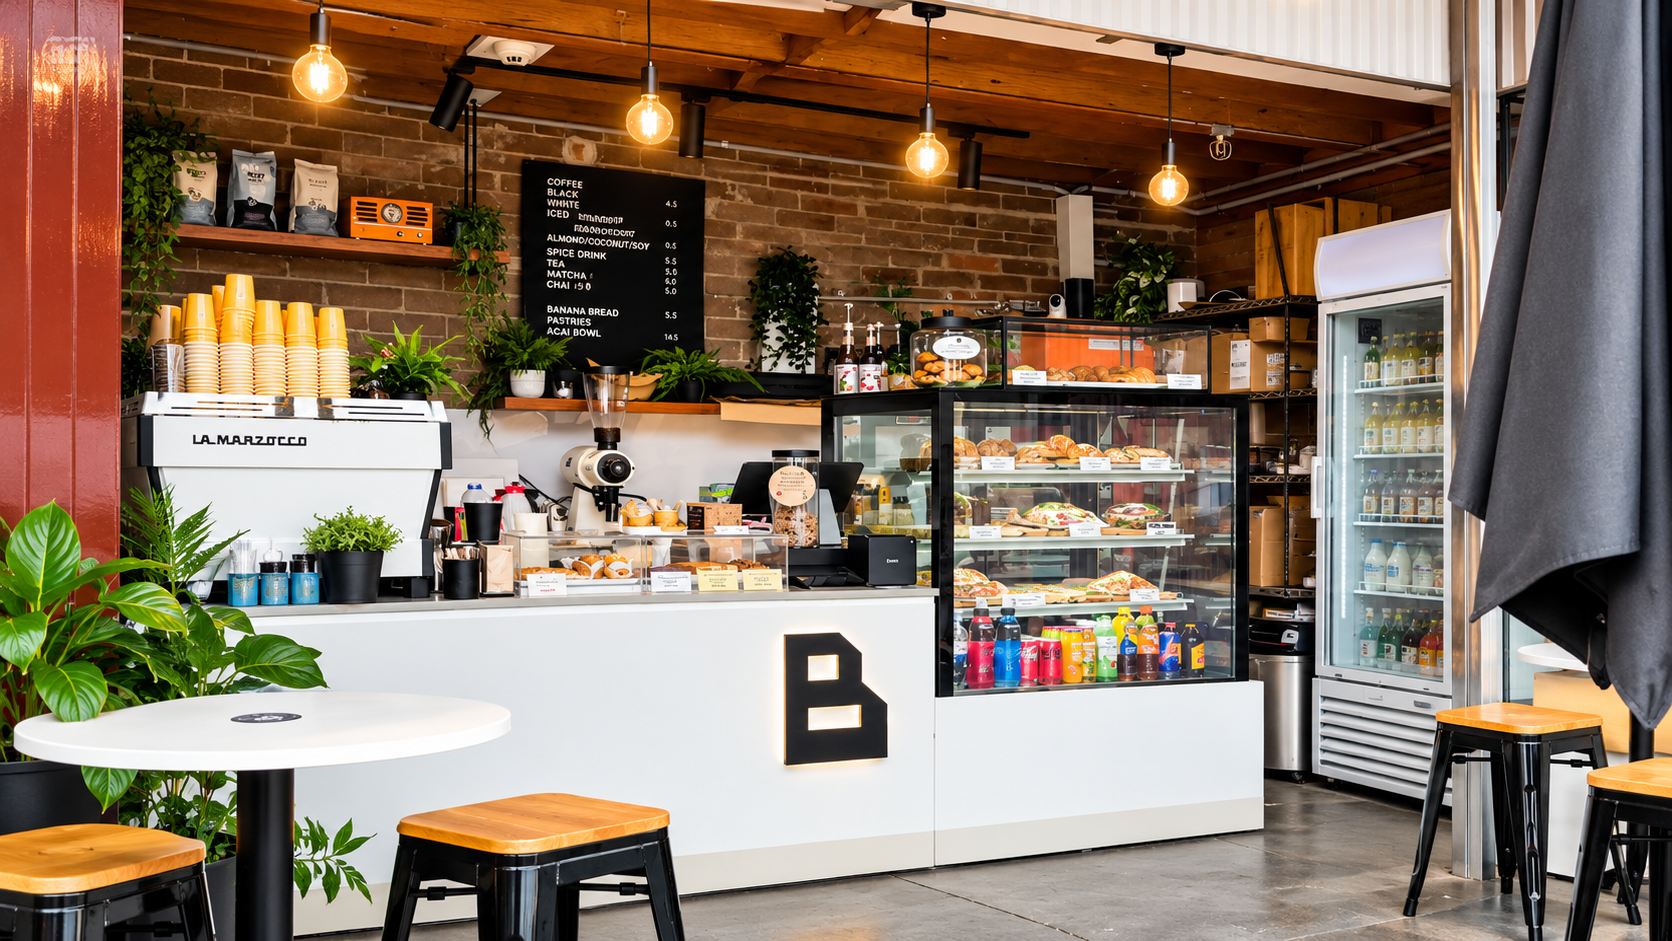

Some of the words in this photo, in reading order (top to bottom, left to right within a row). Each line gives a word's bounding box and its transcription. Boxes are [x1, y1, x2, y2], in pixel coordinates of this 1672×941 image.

[547, 178, 583, 189] COFFEE
[547, 188, 579, 199] BLACK
[665, 200, 678, 208] 4.5
[547, 208, 570, 219] ICED
[665, 219, 678, 228] 0.5
[547, 233, 650, 251] ALMOND/COCONUT/SOY
[546, 247, 575, 258] SPICE
[577, 250, 607, 260] DRINK
[546, 258, 566, 268] TEA
[665, 256, 677, 265] 5.5
[546, 270, 587, 280] MATCHA
[546, 280, 570, 290] CHAI
[546, 305, 586, 315] BANANA
[588, 307, 619, 317] BREAD
[665, 311, 678, 320] 5.5
[547, 316, 592, 327] PASTRIES
[546, 327, 570, 337] ACAI
[573, 328, 601, 338] BOWL
[192, 434, 216, 445] LA
[217, 434, 307, 447] MARZOCCO
[783, 632, 888, 766] B
